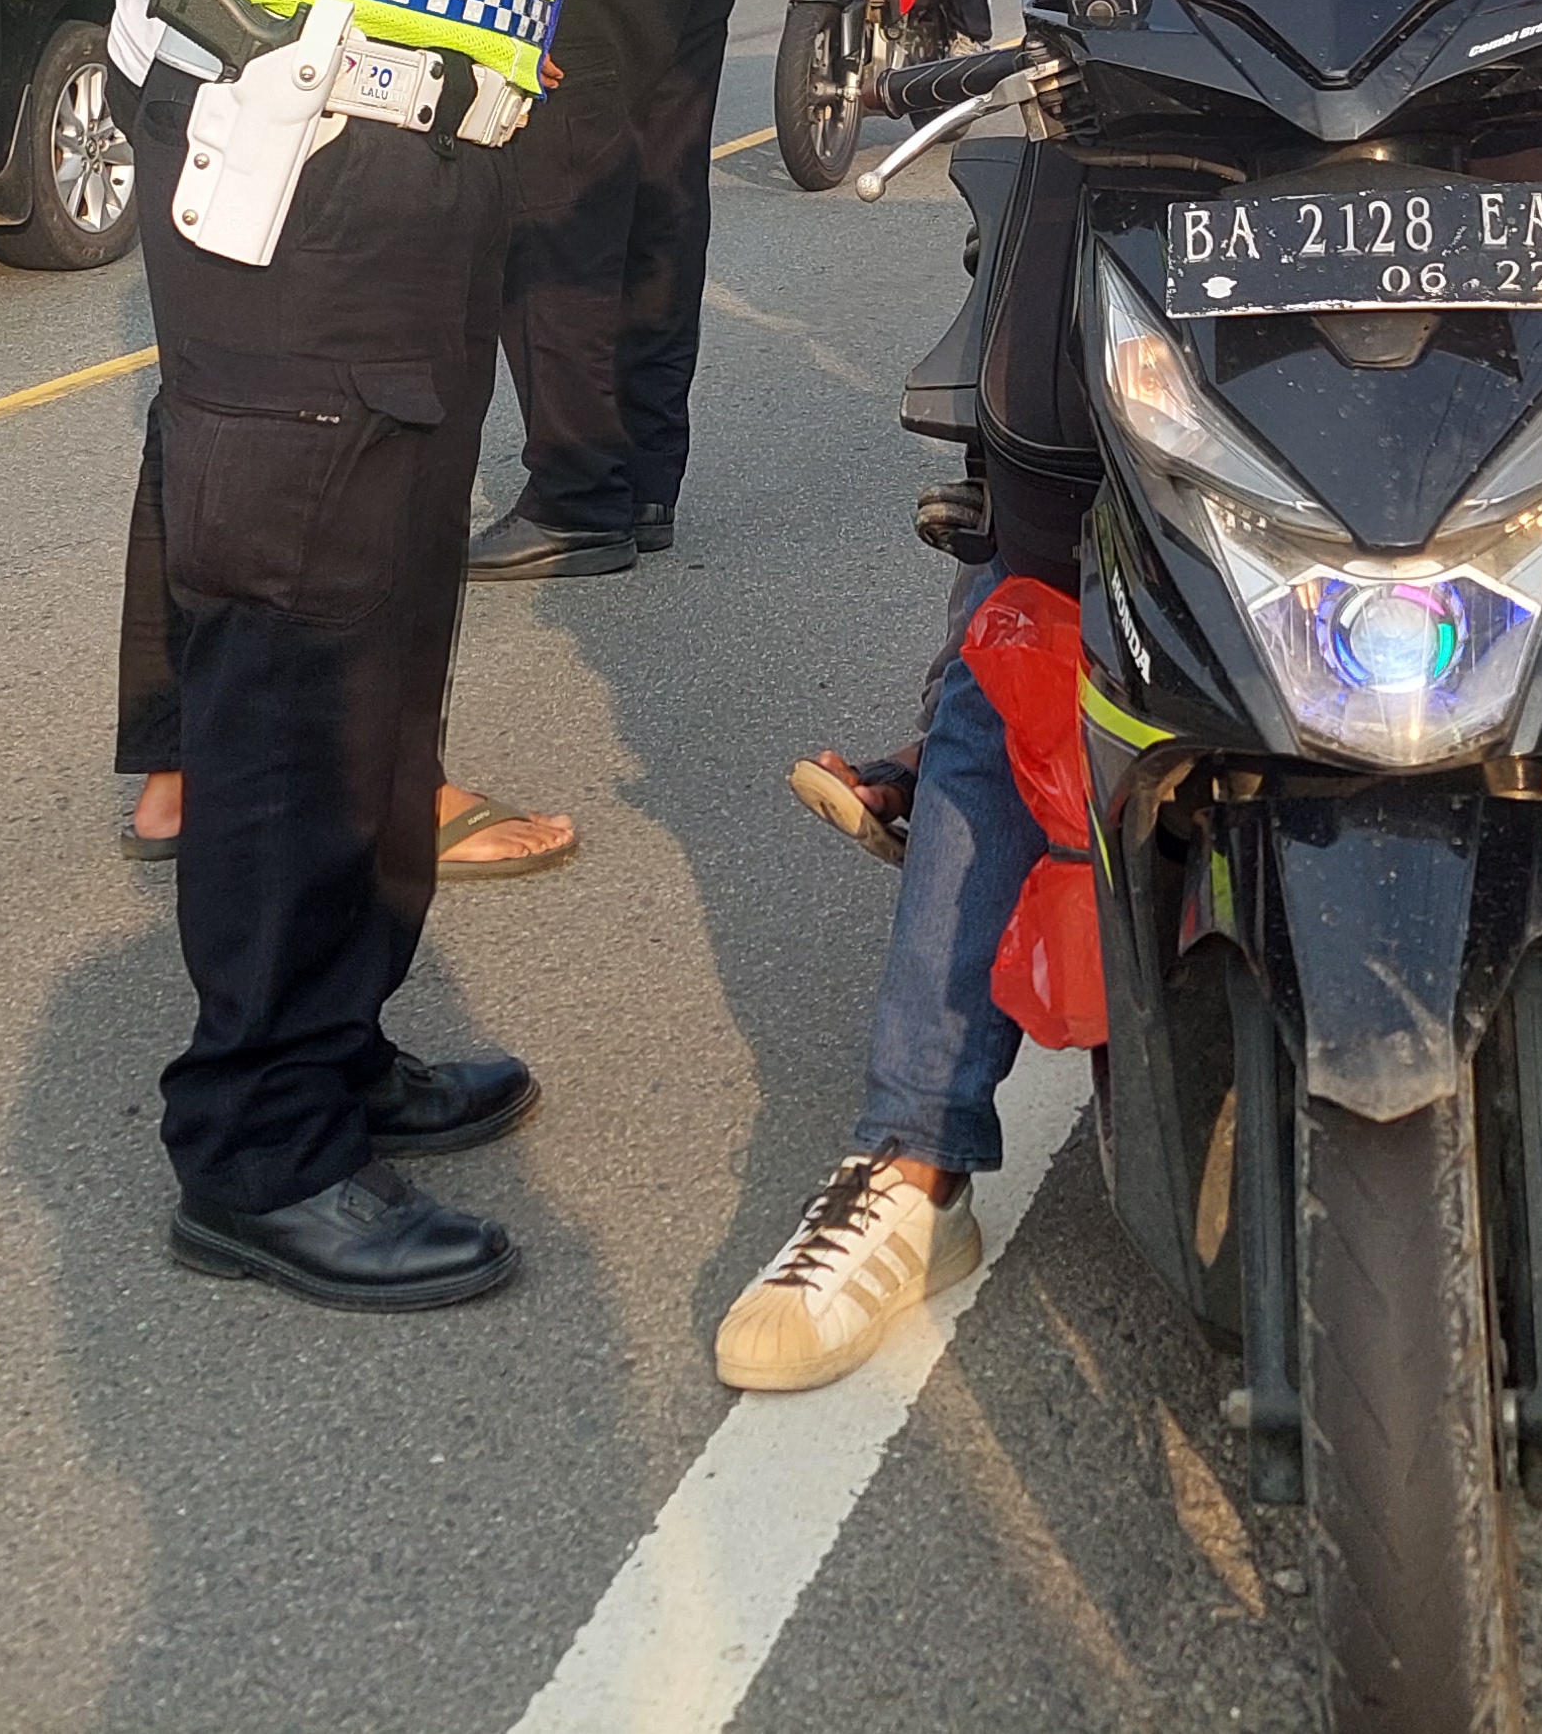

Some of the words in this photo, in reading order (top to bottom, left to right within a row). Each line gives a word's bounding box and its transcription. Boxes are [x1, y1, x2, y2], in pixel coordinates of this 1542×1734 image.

[1468, 31, 1518, 58] Combi
[1183, 206, 1260, 263] BA
[1297, 195, 1435, 258] 2128
